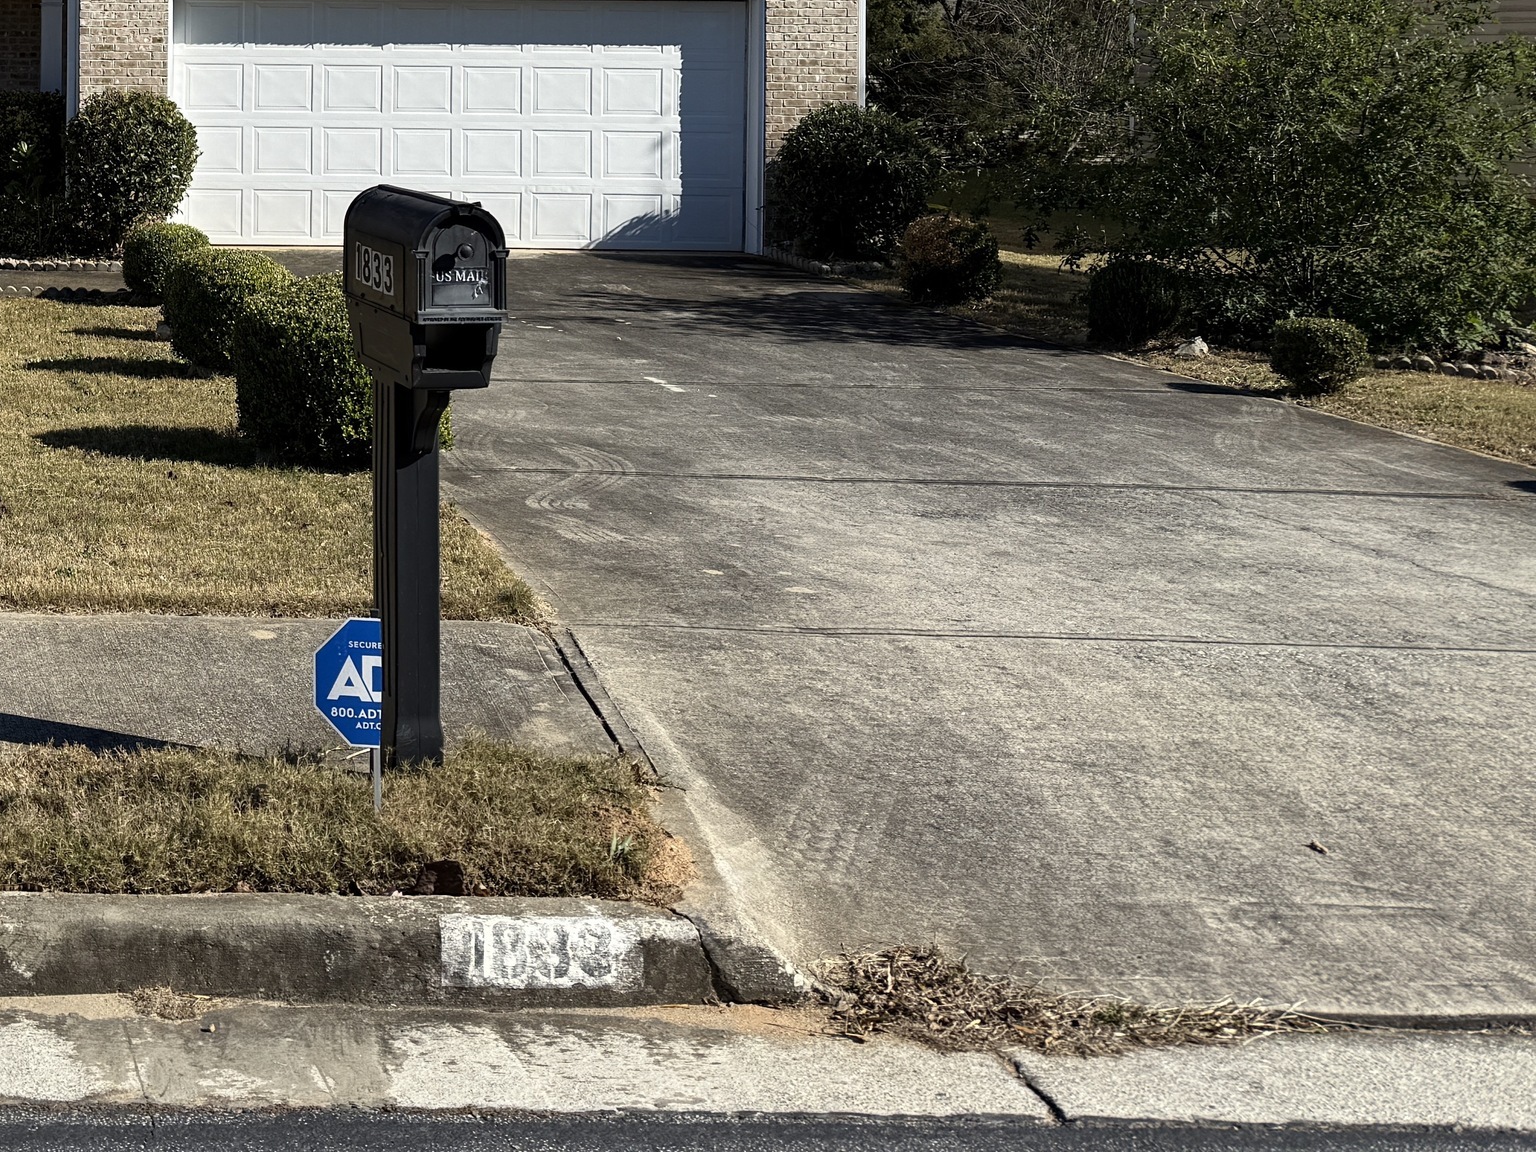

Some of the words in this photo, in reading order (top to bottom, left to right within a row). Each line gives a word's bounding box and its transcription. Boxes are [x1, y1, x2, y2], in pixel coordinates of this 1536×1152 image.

[355, 242, 394, 295] 1833
[436, 270, 452, 282] US
[348, 641, 382, 649] SECURE
[326, 655, 382, 703] AD
[331, 707, 382, 719] 800.ADT
[355, 722, 382, 730] ADT.C
